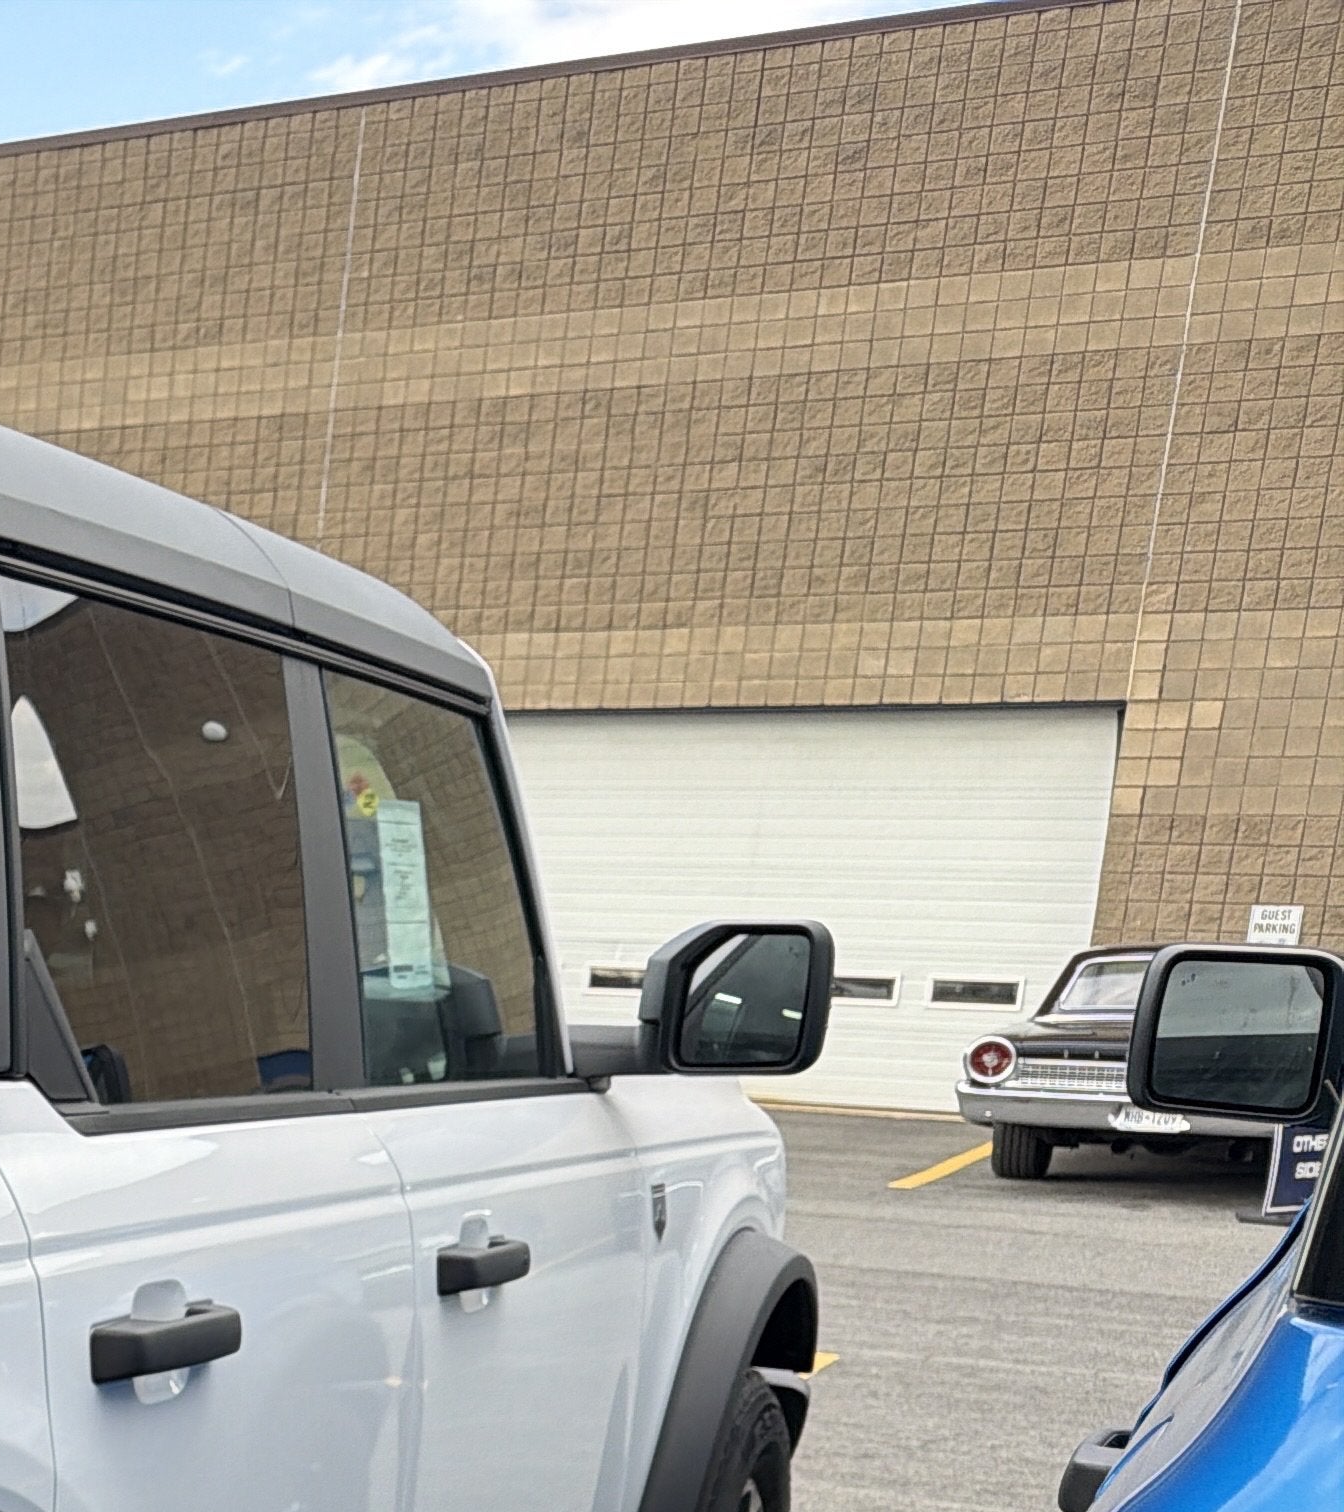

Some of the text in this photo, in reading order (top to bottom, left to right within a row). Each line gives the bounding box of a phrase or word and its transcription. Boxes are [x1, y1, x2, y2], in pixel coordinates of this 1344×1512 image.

[1260, 908, 1293, 921] GUEST
[1253, 922, 1297, 935] PARKING
[1292, 1133, 1329, 1153] OTHE
